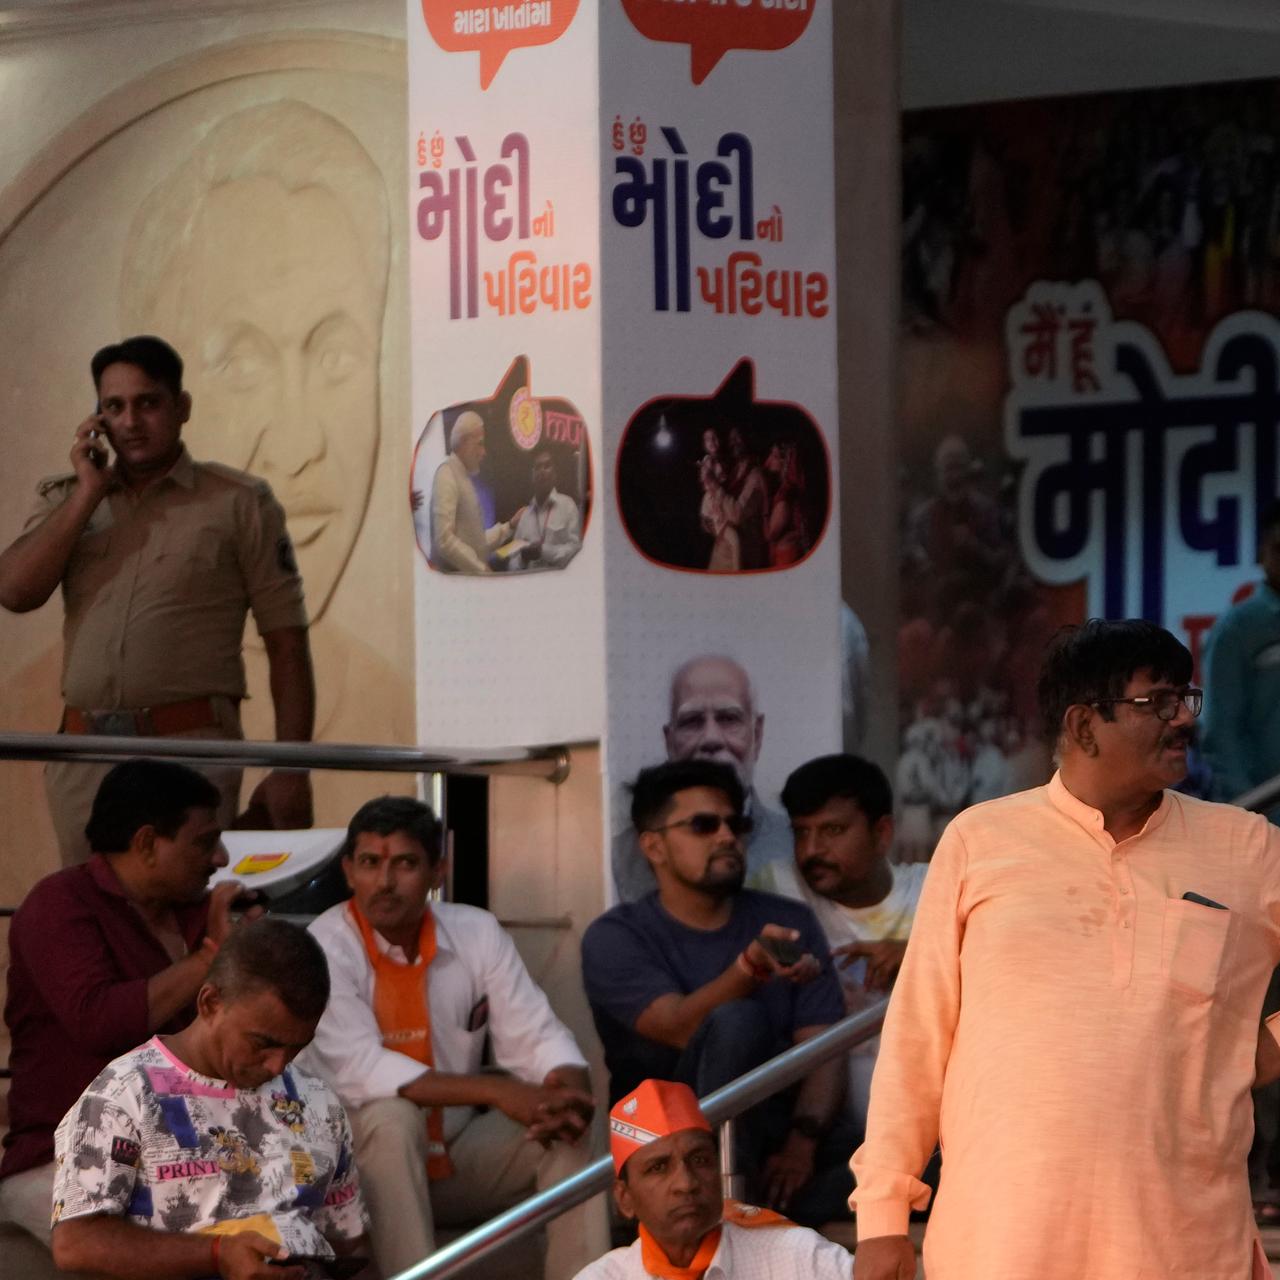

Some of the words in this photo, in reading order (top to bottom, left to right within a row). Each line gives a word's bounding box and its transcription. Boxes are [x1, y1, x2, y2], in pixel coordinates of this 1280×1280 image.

[484, 251, 592, 316] પરિવાર
[697, 251, 830, 318] પરિવાર
[158, 1161, 218, 1181] PRINT
